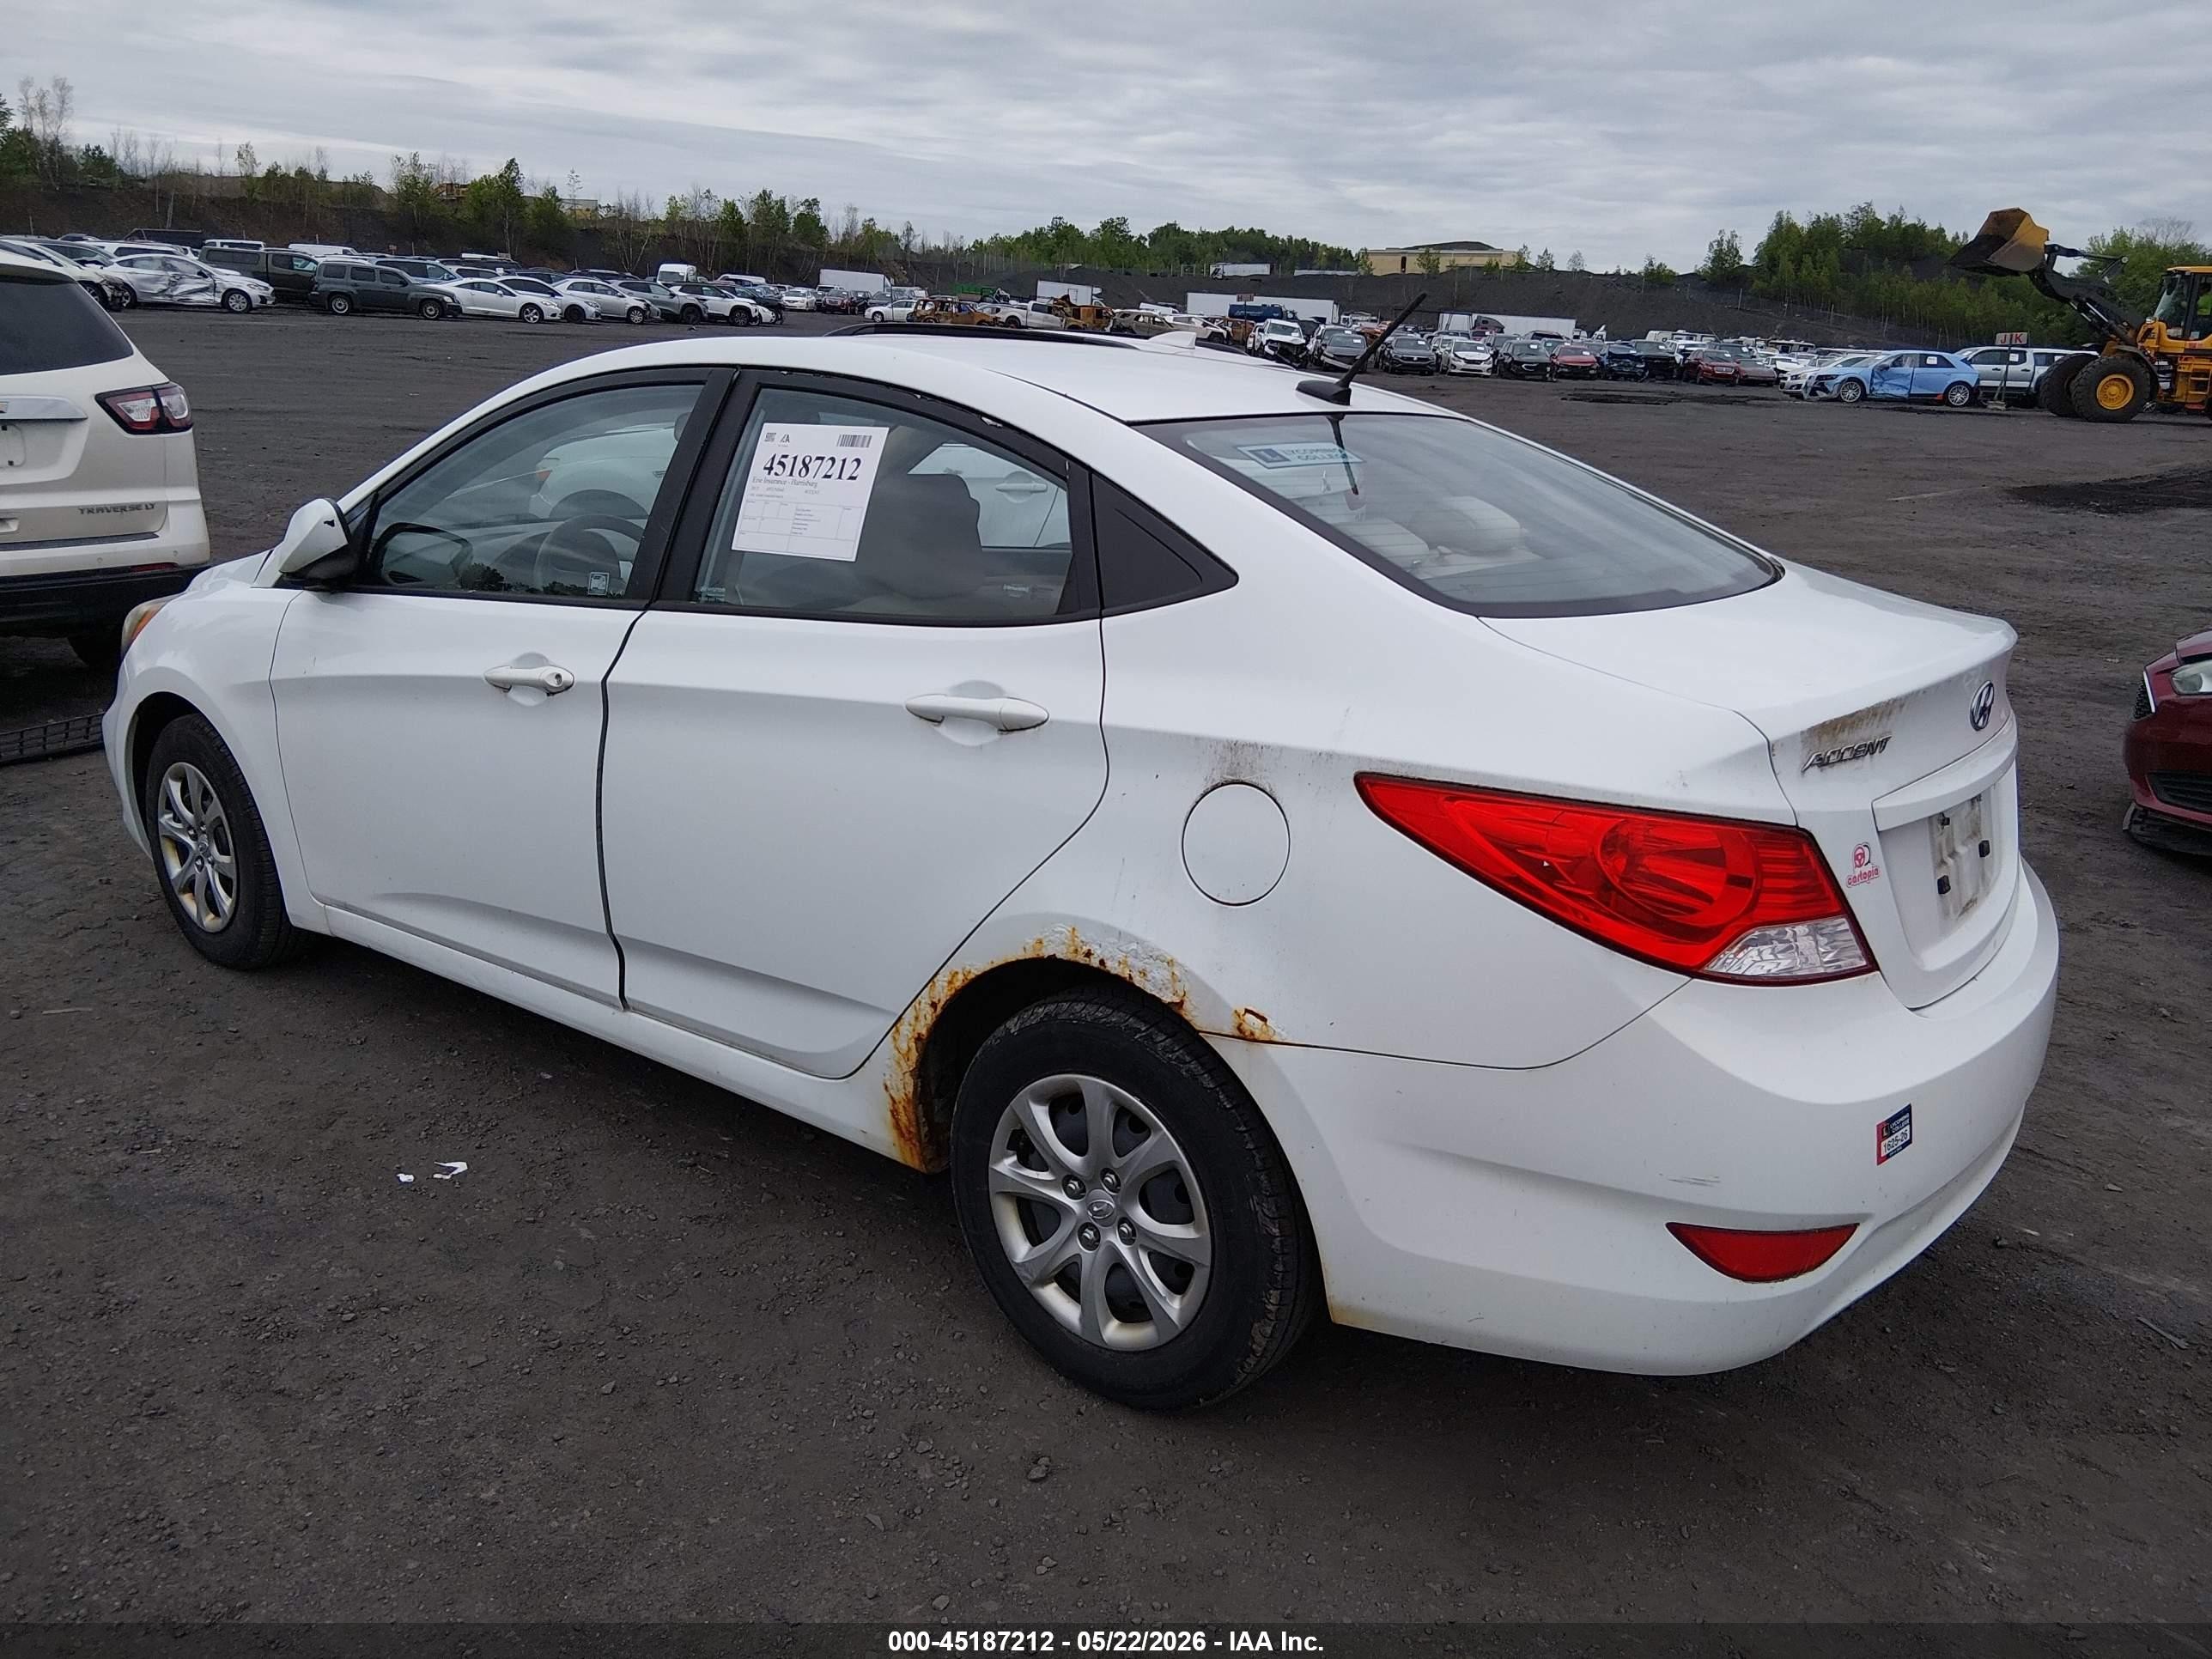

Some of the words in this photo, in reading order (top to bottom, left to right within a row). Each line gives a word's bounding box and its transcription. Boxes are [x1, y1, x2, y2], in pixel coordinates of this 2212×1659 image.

[763, 453, 861, 481] 45187212
[78, 503, 143, 514] TRAVERSE
[1801, 735, 1893, 774] ACCENT
[1847, 867, 1879, 885] cartopia
